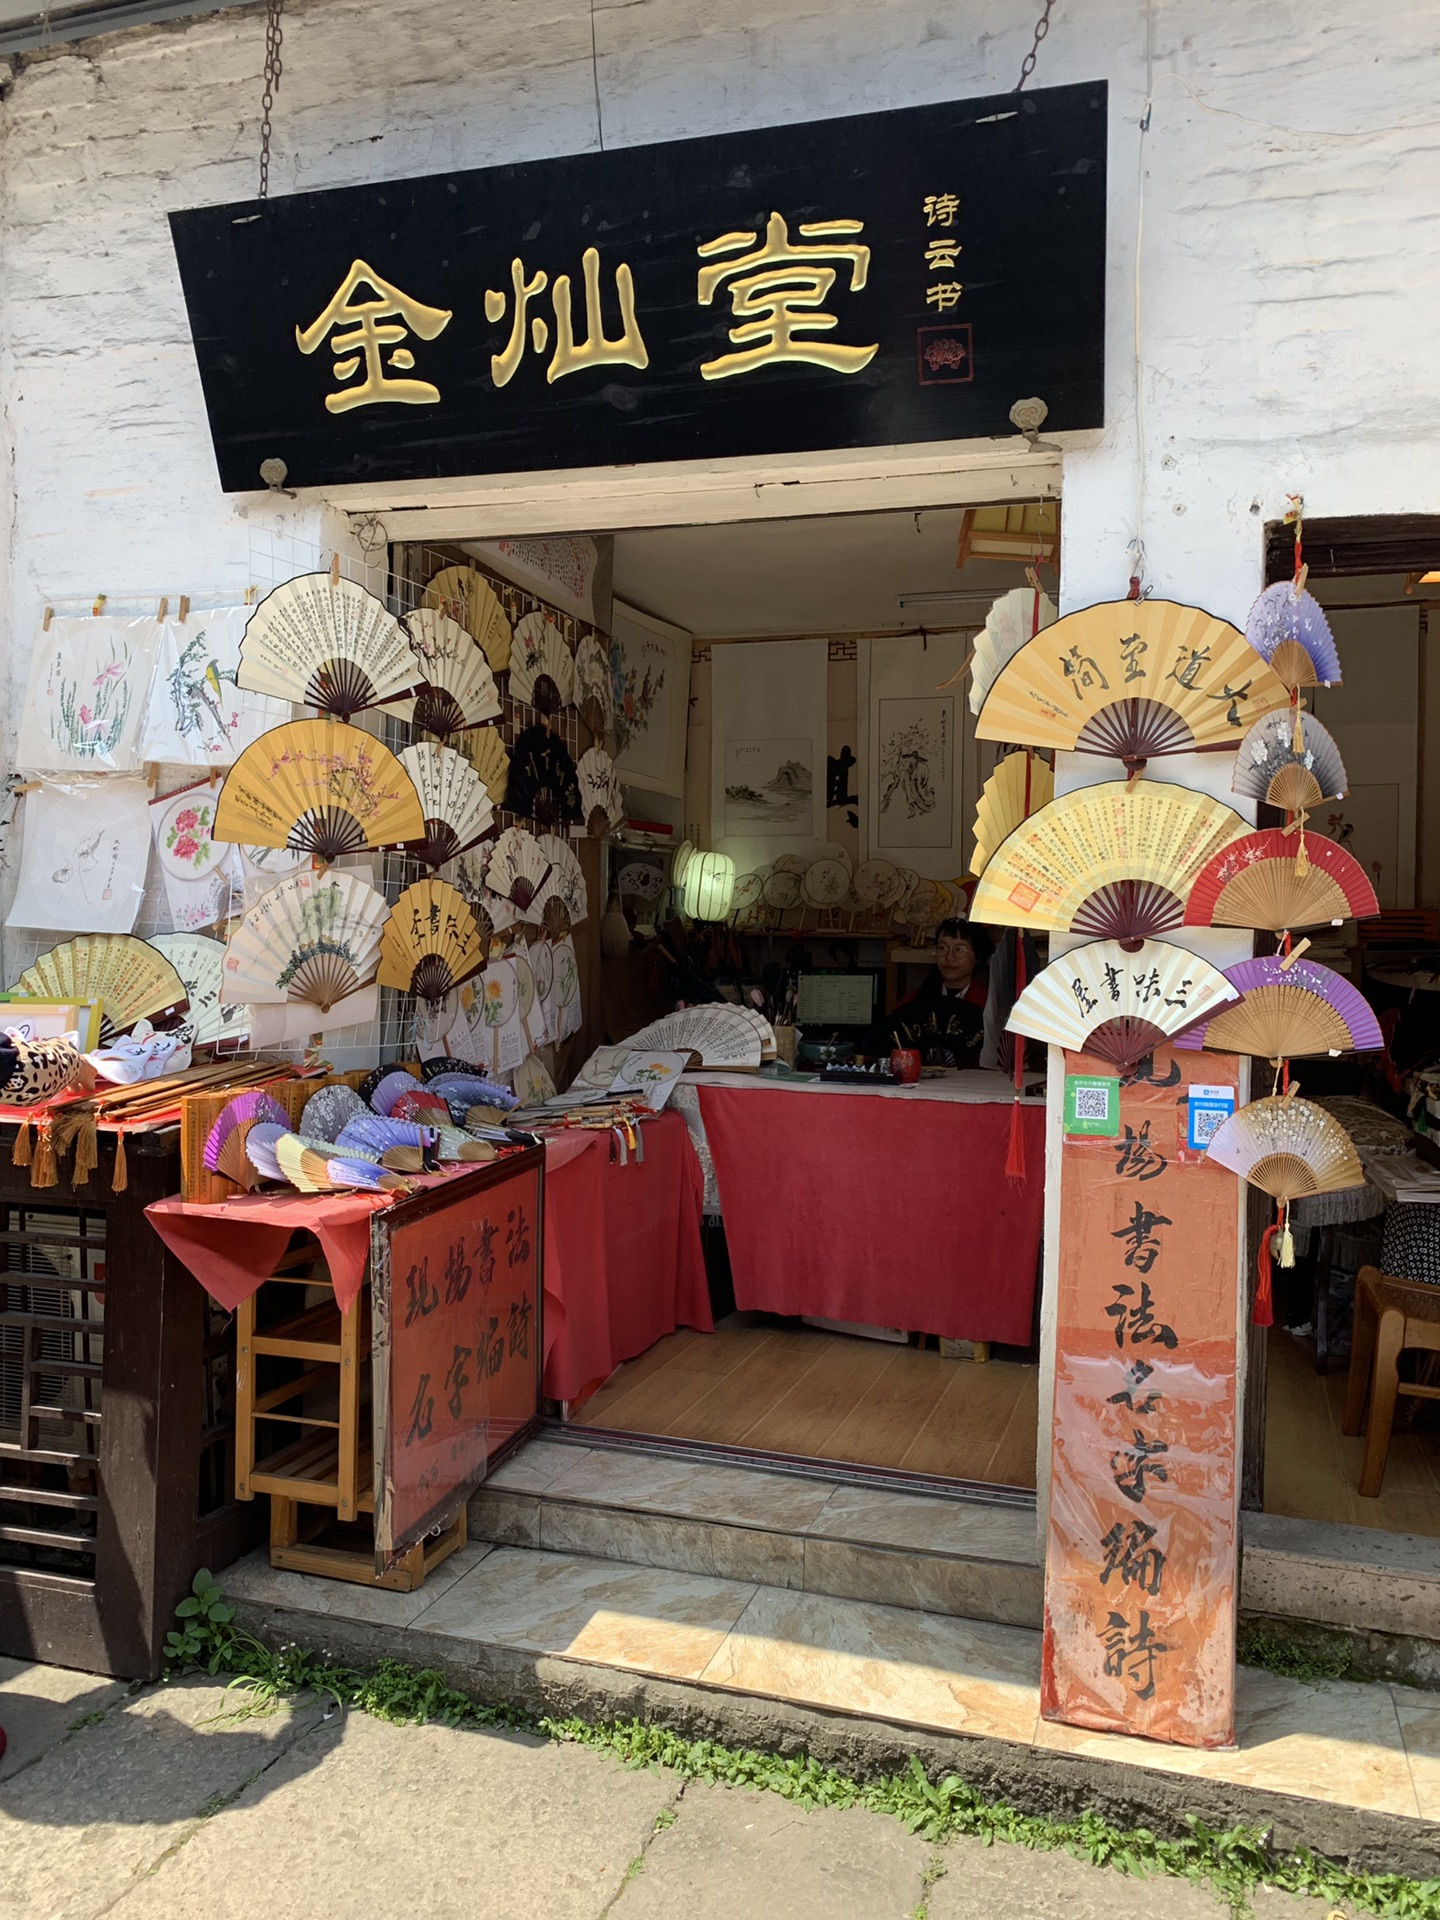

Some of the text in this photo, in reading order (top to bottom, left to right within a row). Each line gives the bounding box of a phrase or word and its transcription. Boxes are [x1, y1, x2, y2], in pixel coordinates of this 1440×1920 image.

[296, 210, 879, 415] 金灿堂
[923, 193, 963, 312] 诗云书
